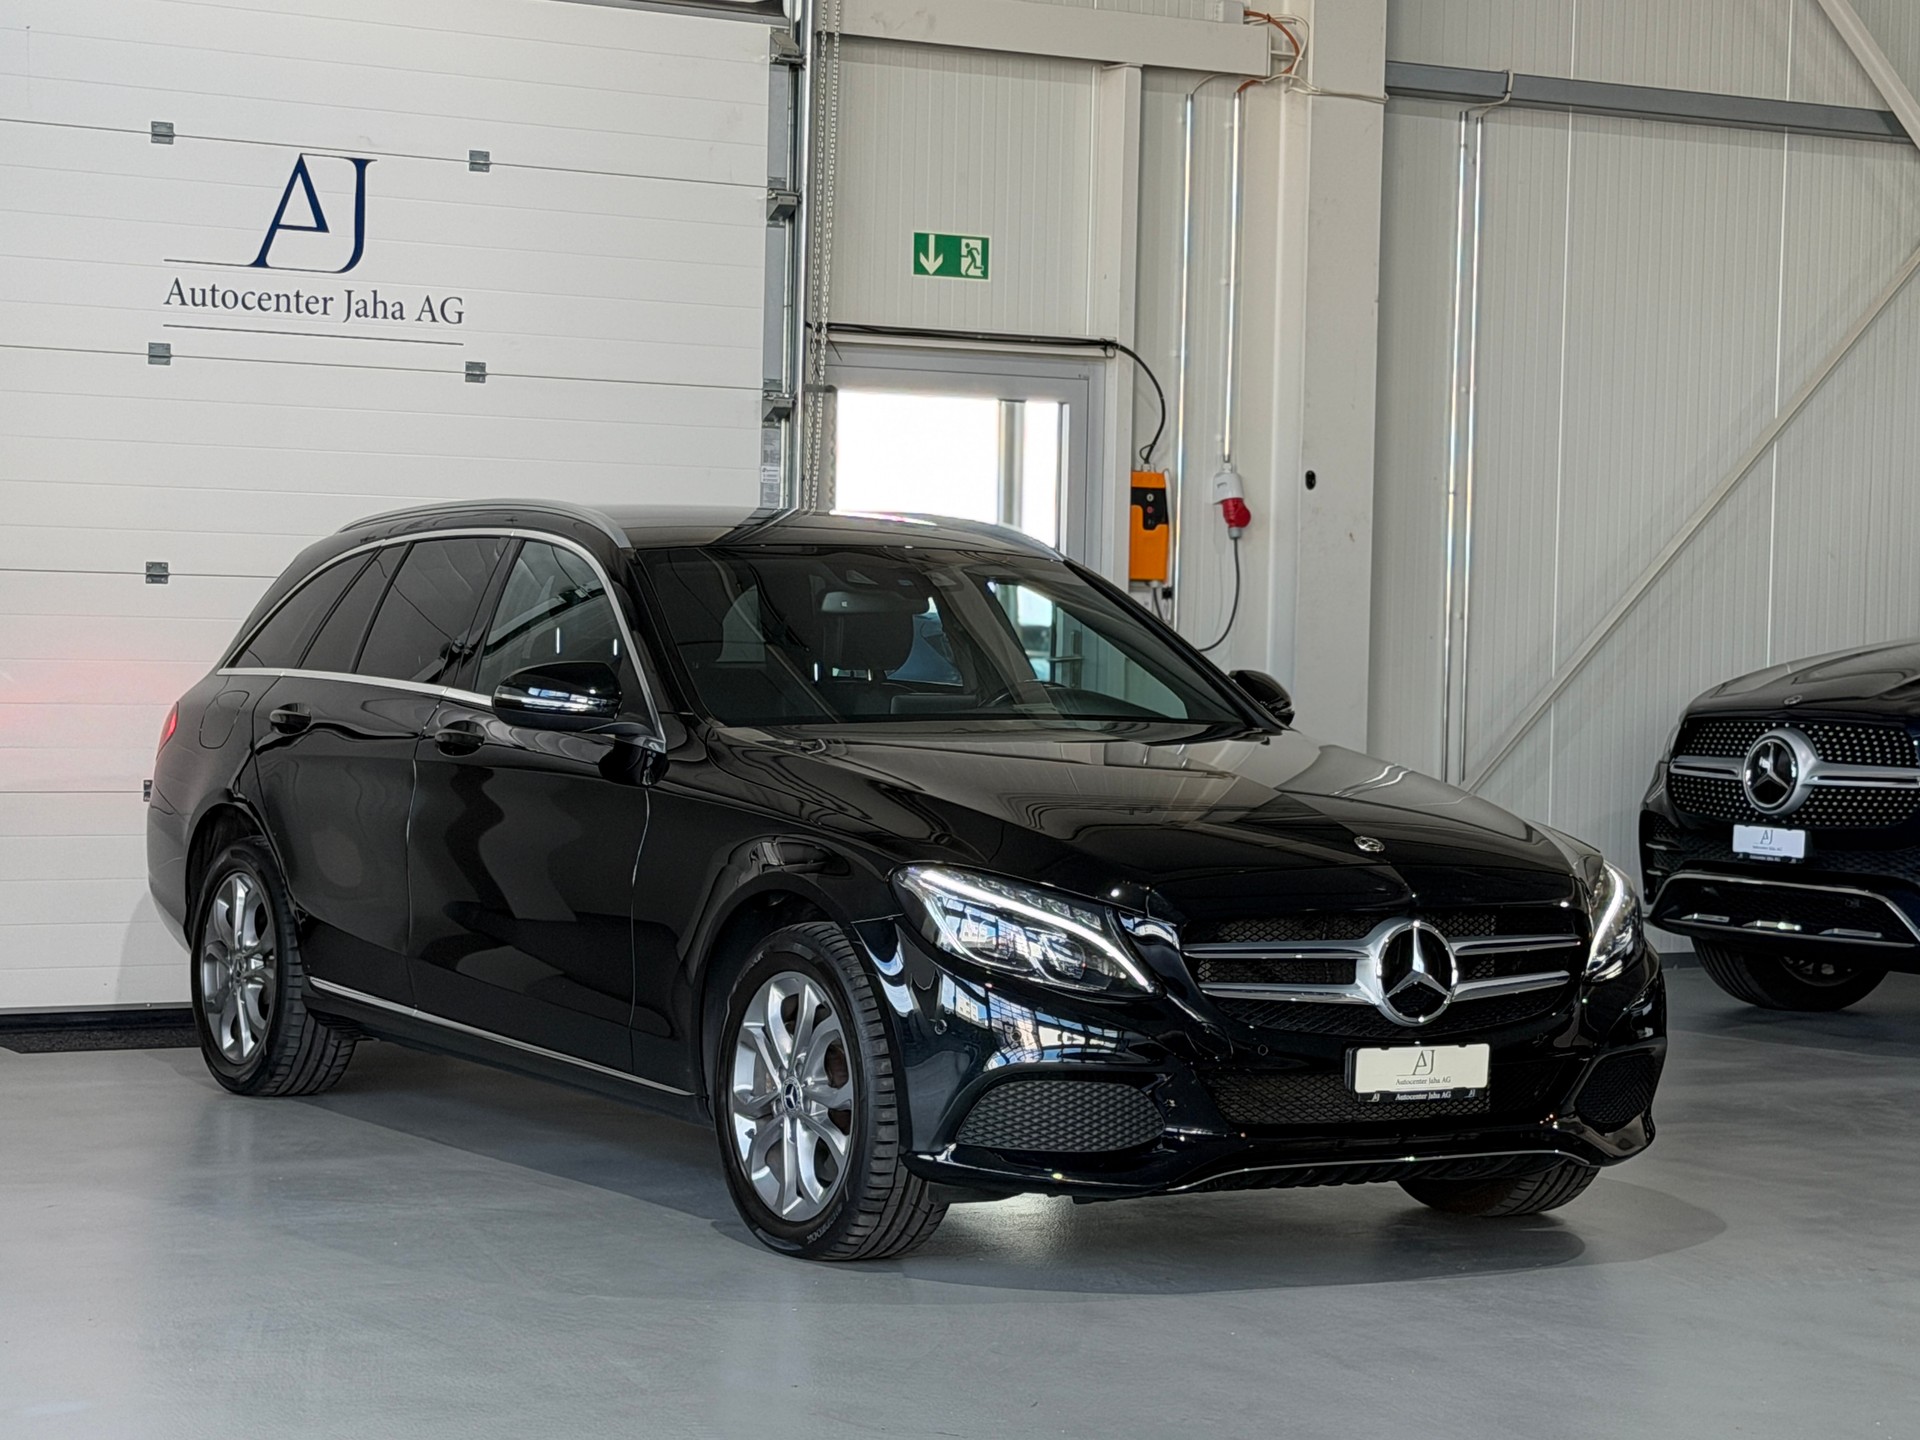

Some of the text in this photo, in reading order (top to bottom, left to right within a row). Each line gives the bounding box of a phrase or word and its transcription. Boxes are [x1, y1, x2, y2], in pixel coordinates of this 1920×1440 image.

[248, 152, 378, 274] AJ
[162, 277, 465, 325] Autocenter Jaha AG
[1412, 1049, 1435, 1076] AJ
[1395, 1075, 1452, 1086] Autocenter Jaha AG
[1394, 1093, 1428, 1101] Autocenter
[1428, 1091, 1441, 1100] Jaha
[1441, 1090, 1452, 1099] AG
